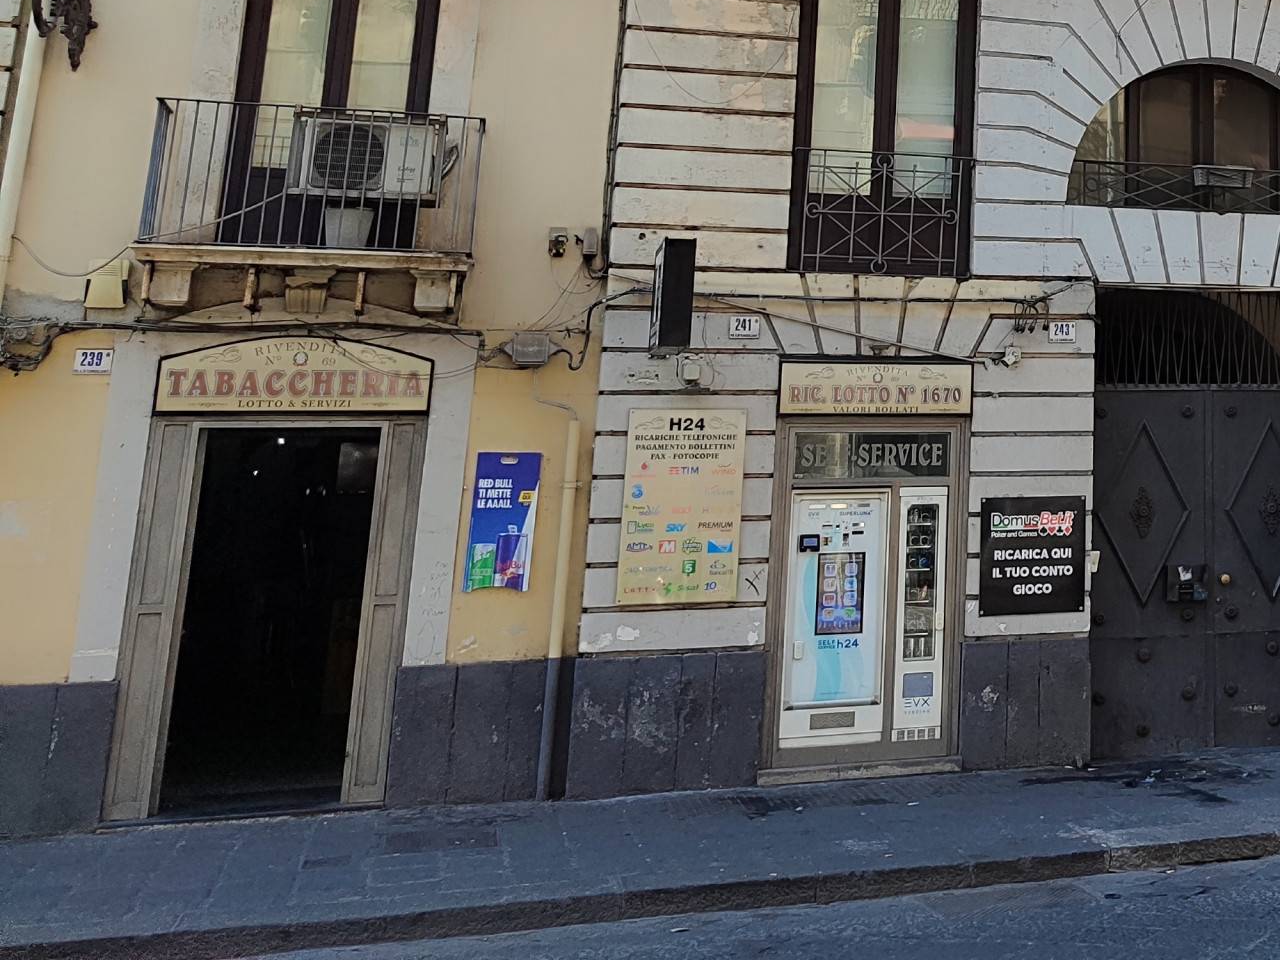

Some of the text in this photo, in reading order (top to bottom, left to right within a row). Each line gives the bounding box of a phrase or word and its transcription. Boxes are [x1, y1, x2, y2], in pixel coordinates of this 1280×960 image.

[735, 318, 752, 331] 241
[1054, 323, 1070, 336] 243
[255, 341, 347, 357] RIVENDITA
[80, 351, 103, 367] 239
[167, 368, 424, 398] TABACCHERIA
[789, 384, 826, 405] RIC.
[832, 384, 890, 405] LOTTO
[920, 385, 963, 405] 1670
[238, 399, 352, 408] LOTTO & SERVIZI
[669, 417, 705, 431] H24
[683, 433, 737, 441] TELEFONICHE
[673, 452, 720, 460] FOTOCOPIE
[801, 443, 943, 467] SE-SERVICE
[681, 466, 699, 475] TIM
[478, 478, 513, 488] RED BULL
[479, 488, 512, 498] TI METTE
[477, 498, 486, 508] LE
[698, 521, 734, 529] PREMIUM
[993, 548, 1072, 561] RICARICA QUI
[992, 565, 1073, 578] IL TUO CONTO
[1013, 583, 1053, 595] GIOCO
[836, 638, 860, 649] h24
